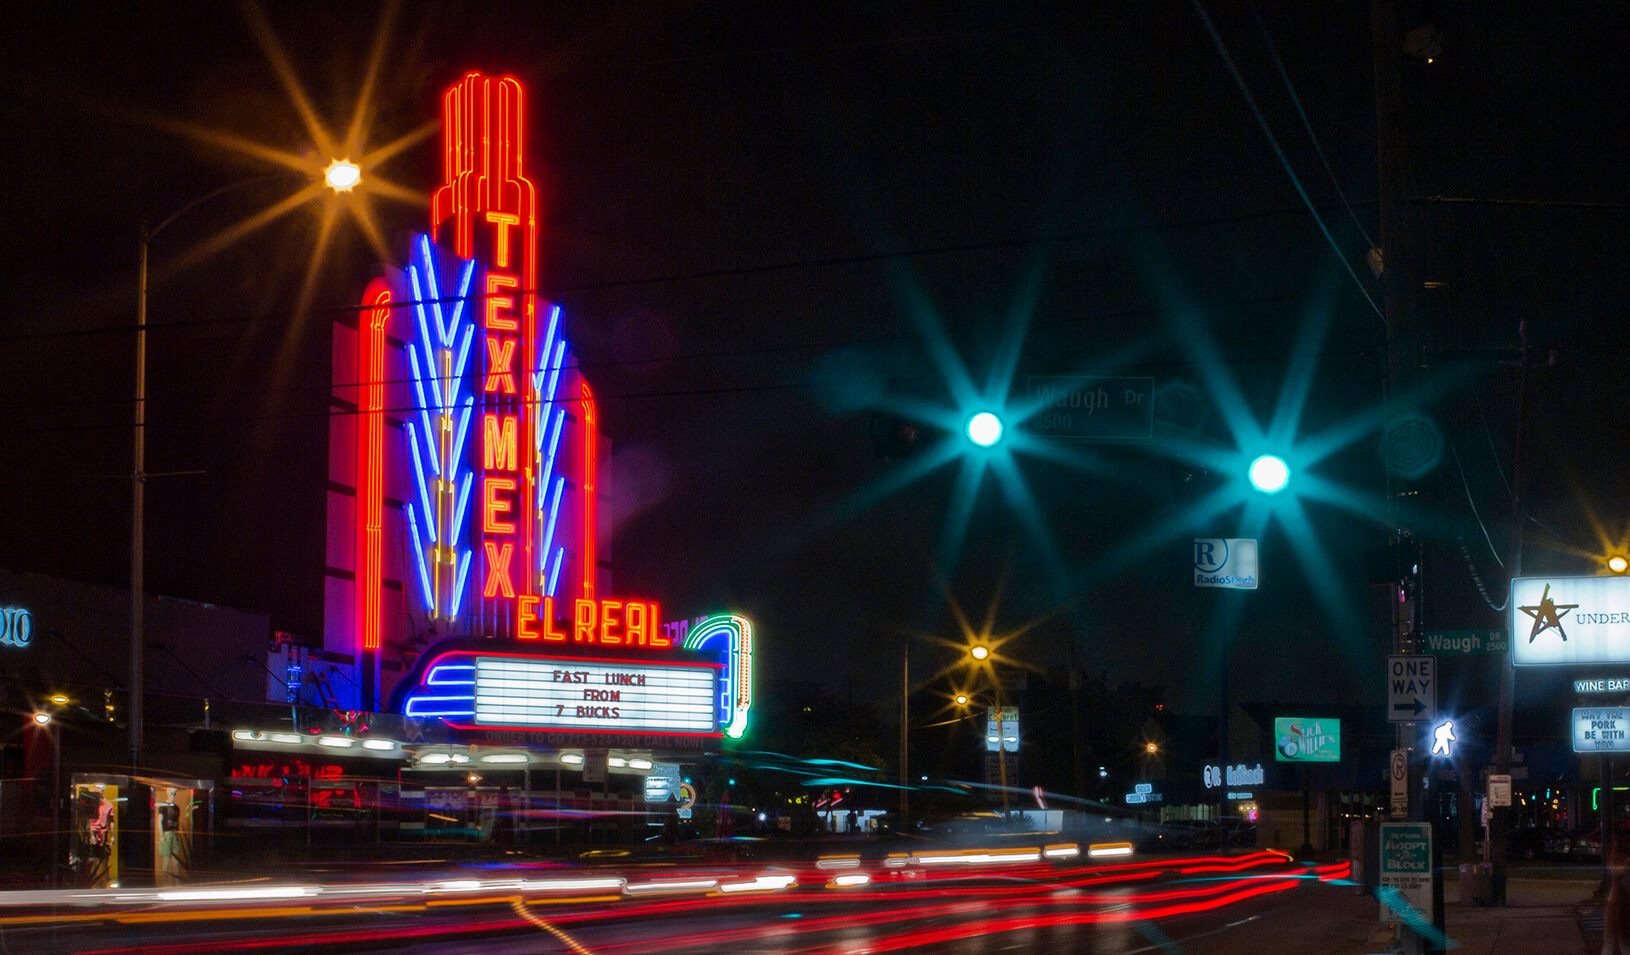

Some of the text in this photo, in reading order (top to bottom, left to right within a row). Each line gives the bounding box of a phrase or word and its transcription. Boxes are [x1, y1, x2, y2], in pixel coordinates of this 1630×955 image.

[1125, 390, 1144, 404] Dr
[482, 210, 520, 600] TEX MEX
[1196, 574, 1256, 585] RadioShack
[515, 594, 566, 642] EL
[573, 597, 672, 649] REAL
[1576, 612, 1630, 625] UNDER
[1428, 632, 1501, 653] Waugh DR
[1486, 641, 1507, 651] 2500
[1392, 661, 1430, 677] ONE
[553, 670, 646, 687] FAST LUNCH
[1392, 679, 1430, 695] WAY
[1575, 679, 1630, 693] WINE BAR
[583, 688, 620, 702] FROM
[555, 704, 620, 719] 7 BUCKS
[1605, 710, 1624, 720] THE
[1591, 720, 1616, 730] PORK
[486, 731, 525, 743] ORDER
[531, 732, 545, 744] TO
[550, 733, 565, 745] GO
[644, 735, 671, 747] CALL
[1584, 730, 1625, 740] BE WITH
[1594, 740, 1614, 750] YOU
[1385, 840, 1428, 851] ADOPT
[1386, 859, 1426, 870] BLOCK
